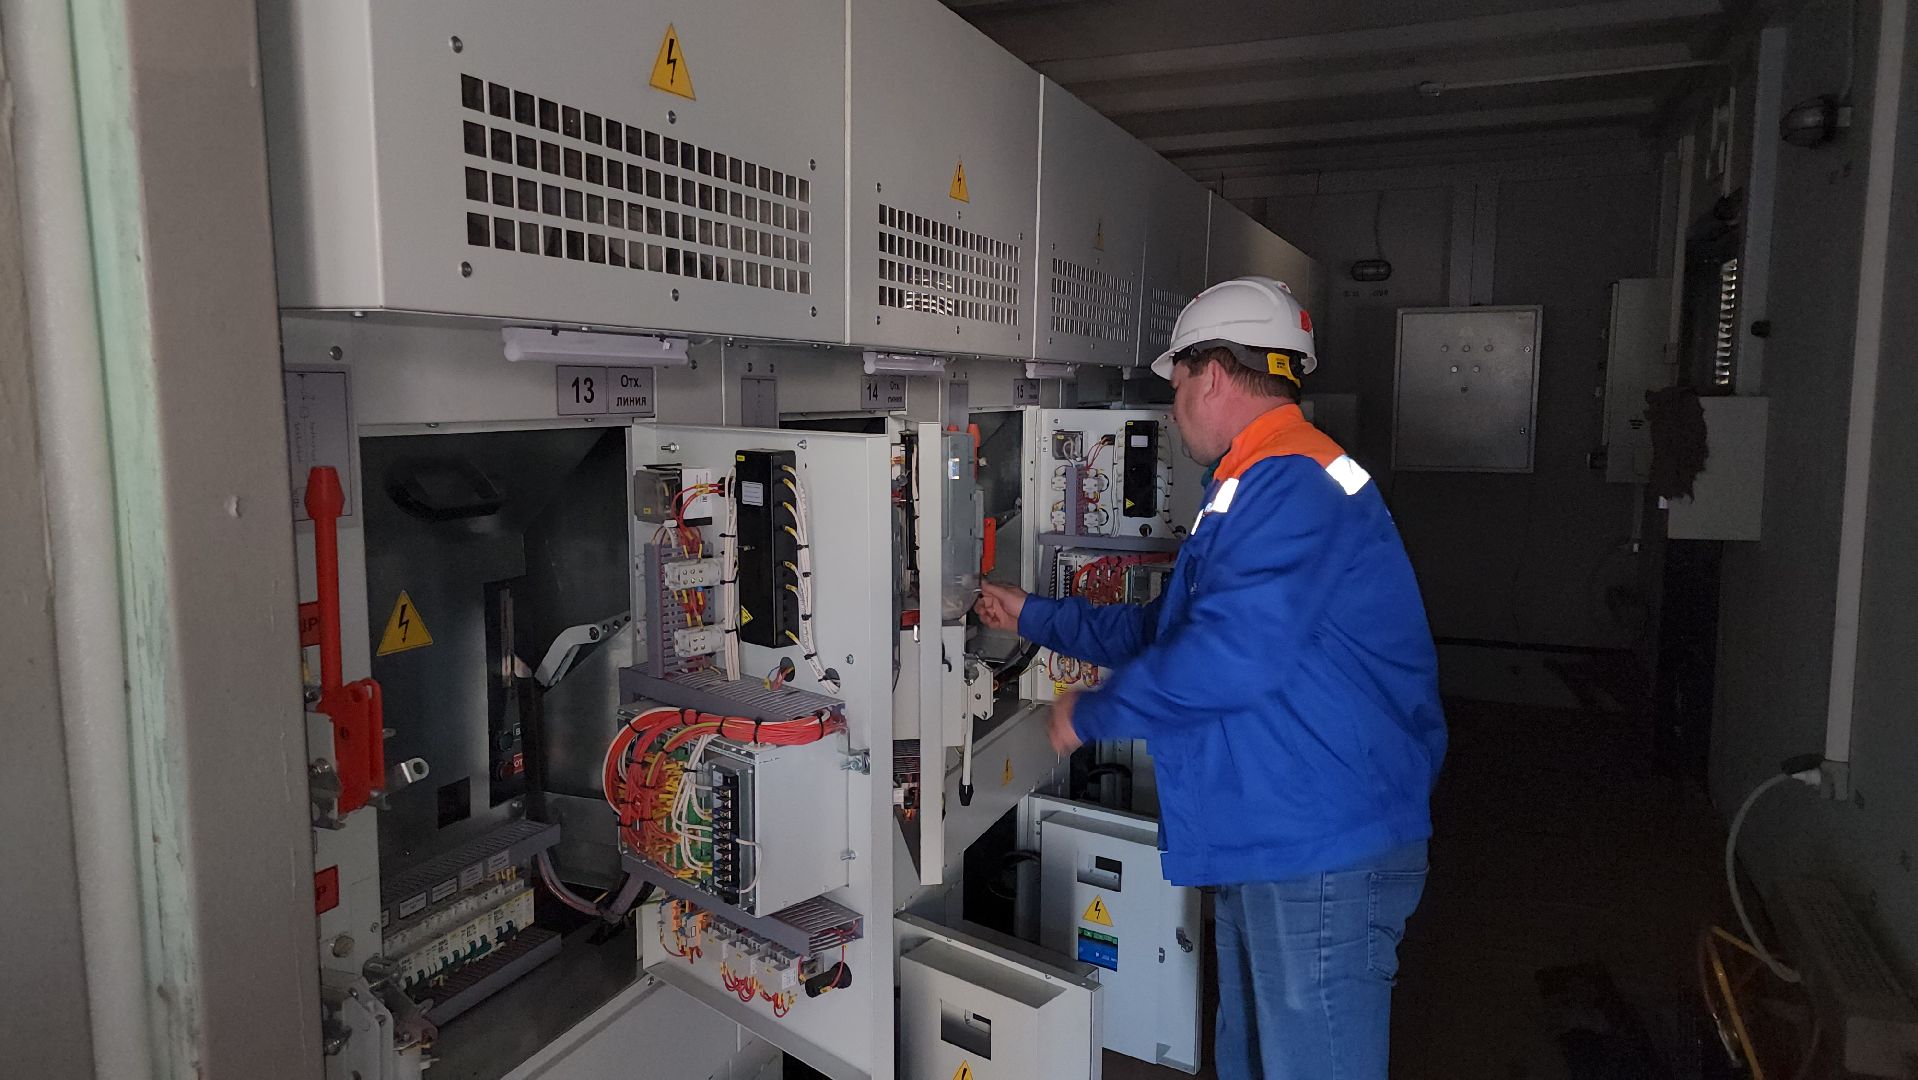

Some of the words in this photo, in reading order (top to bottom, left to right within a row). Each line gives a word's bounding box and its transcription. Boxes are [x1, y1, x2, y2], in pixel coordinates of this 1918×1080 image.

[620, 374, 642, 388] Отх.
[571, 376, 595, 404] 13
[866, 382, 879, 401] 14
[1016, 384, 1024, 399] 15
[616, 396, 647, 407] линия
